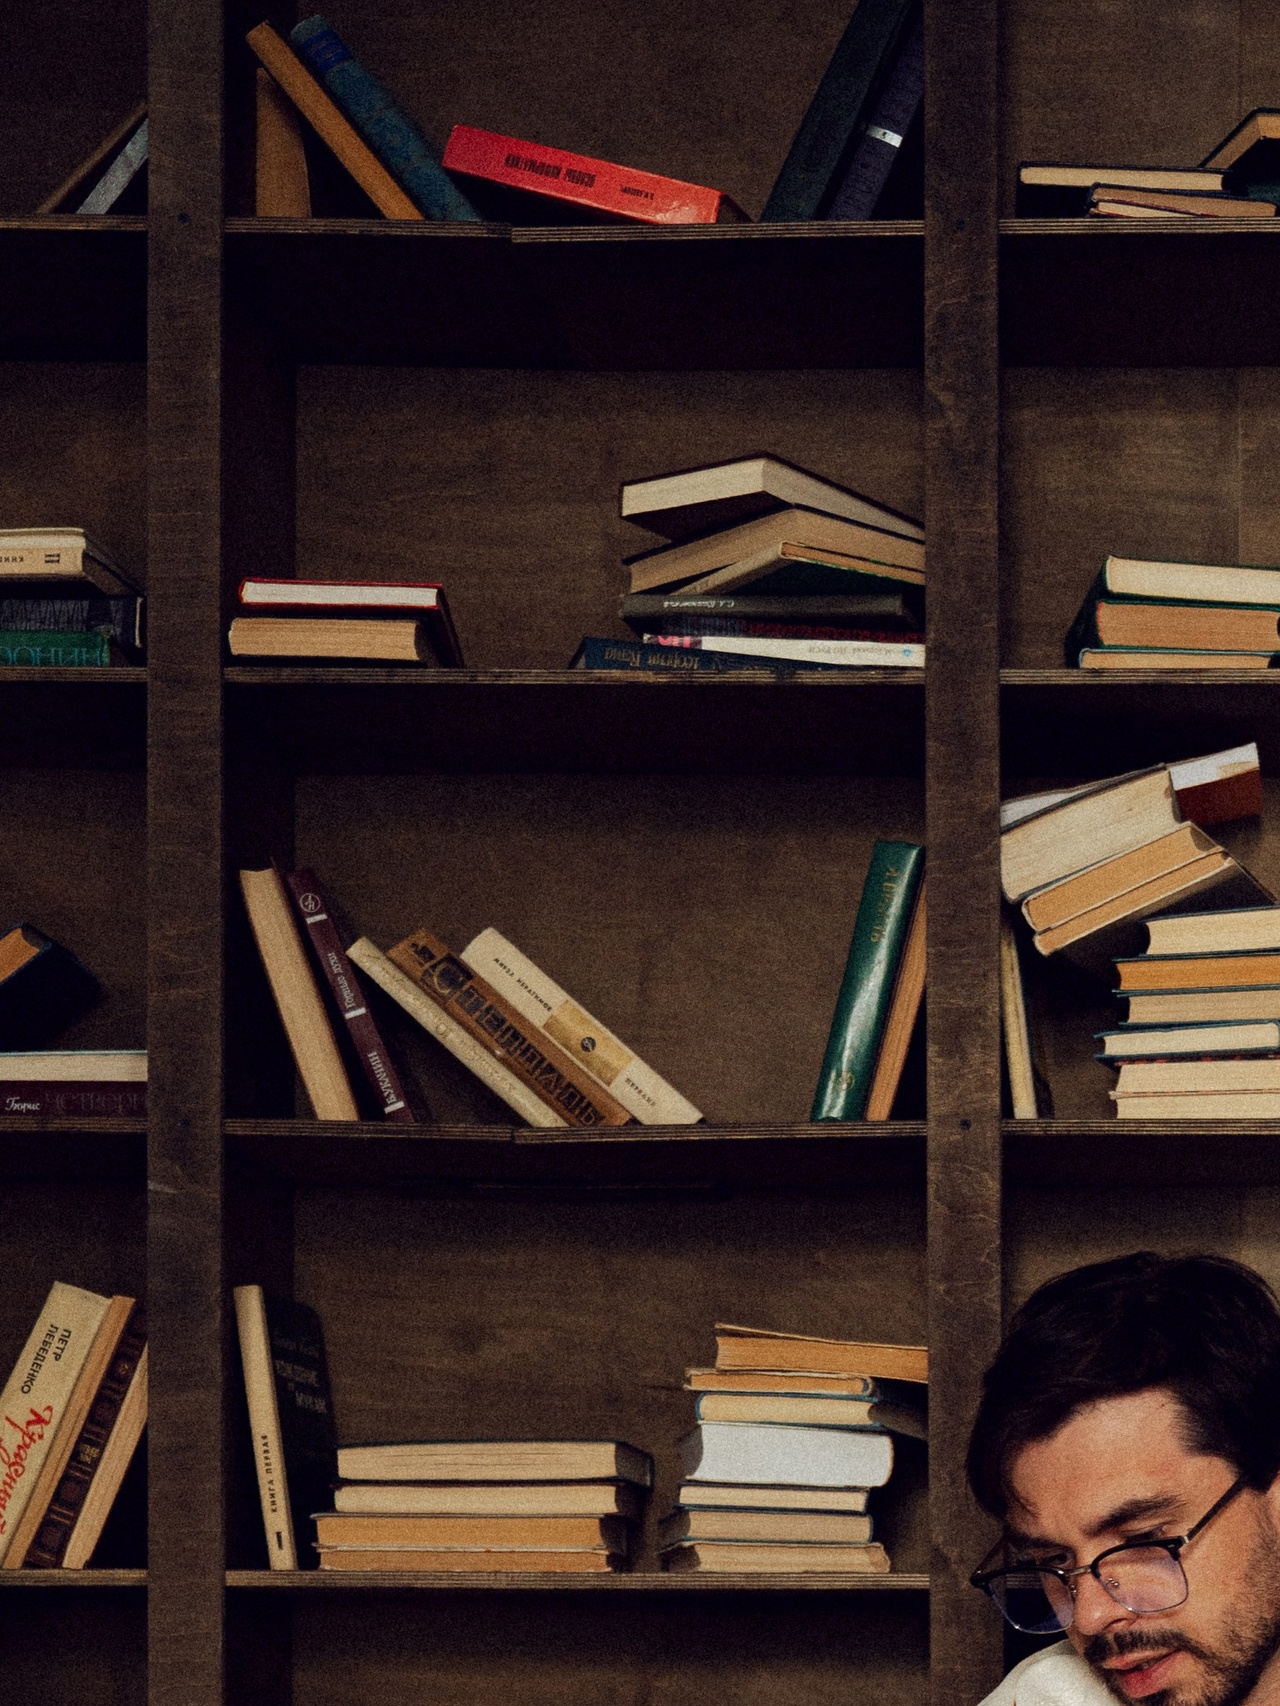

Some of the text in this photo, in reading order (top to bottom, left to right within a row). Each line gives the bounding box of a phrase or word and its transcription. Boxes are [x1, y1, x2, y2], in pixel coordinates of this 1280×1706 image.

[434, 956, 597, 1126] СТЕНДАЛЬ
[21, 1323, 60, 1395] ЛЕБЕДЕНКО
[54, 1328, 73, 1363] ПЕТР
[260, 1434, 279, 1513] КНИГА ПЕРВАЯ
